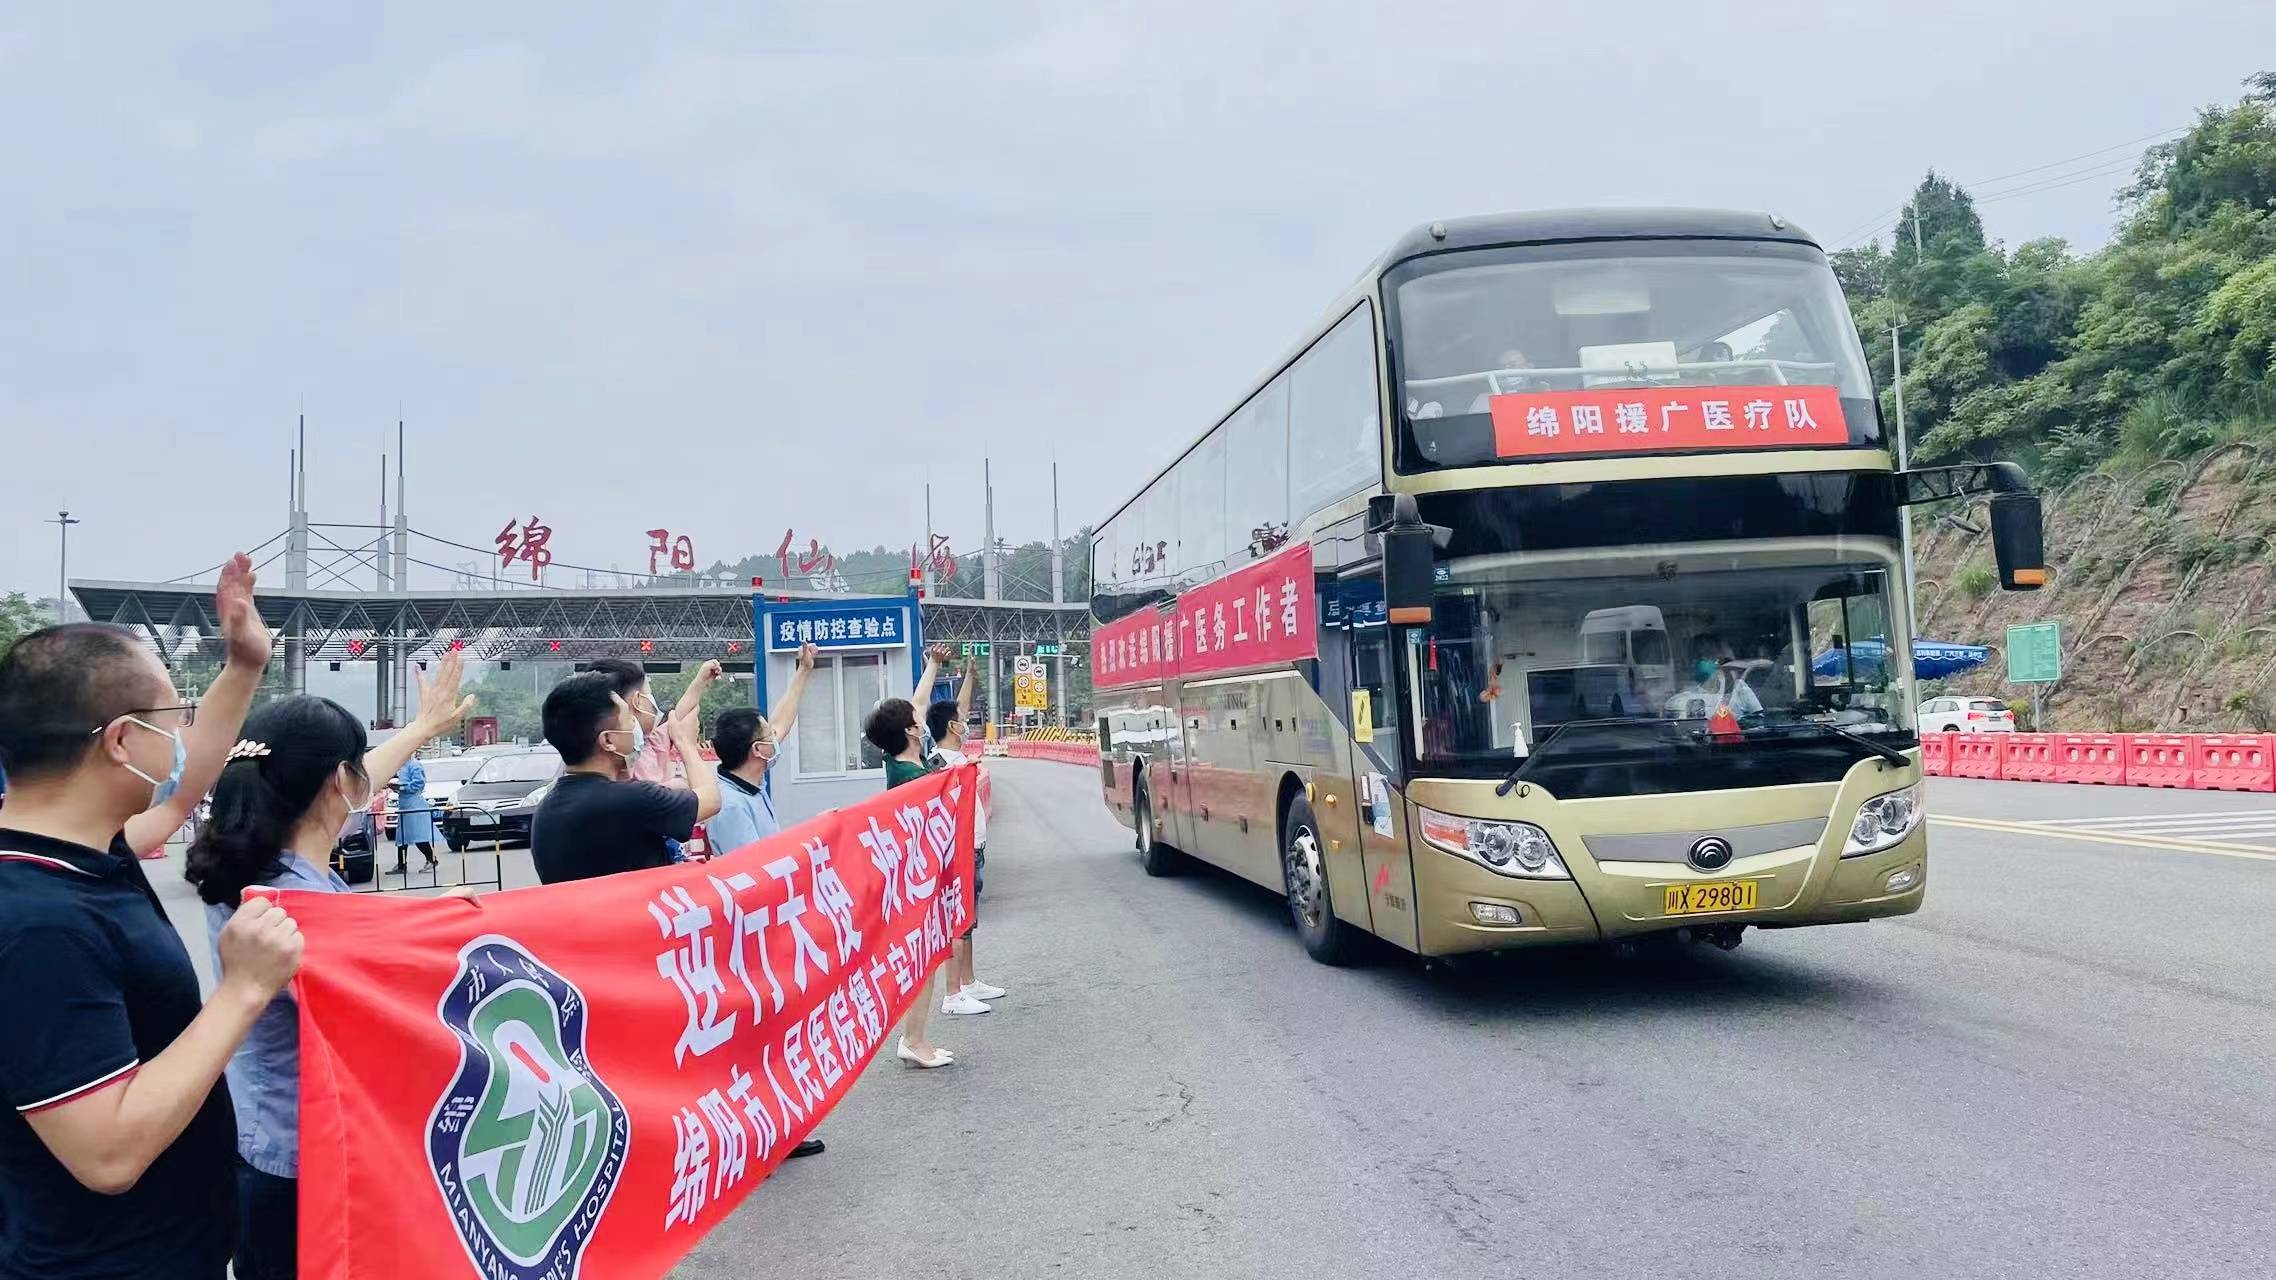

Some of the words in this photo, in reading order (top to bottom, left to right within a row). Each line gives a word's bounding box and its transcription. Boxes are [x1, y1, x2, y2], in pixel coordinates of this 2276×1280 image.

[1526, 399, 1818, 438] 绵阳援广医疗队
[780, 615, 897, 641] 疫情防控查验点
[962, 643, 989, 655] ETC
[647, 836, 863, 1071] 逆行天使
[857, 784, 962, 925] 欢迎回
[574, 1101, 625, 1240] HOSPITAL
